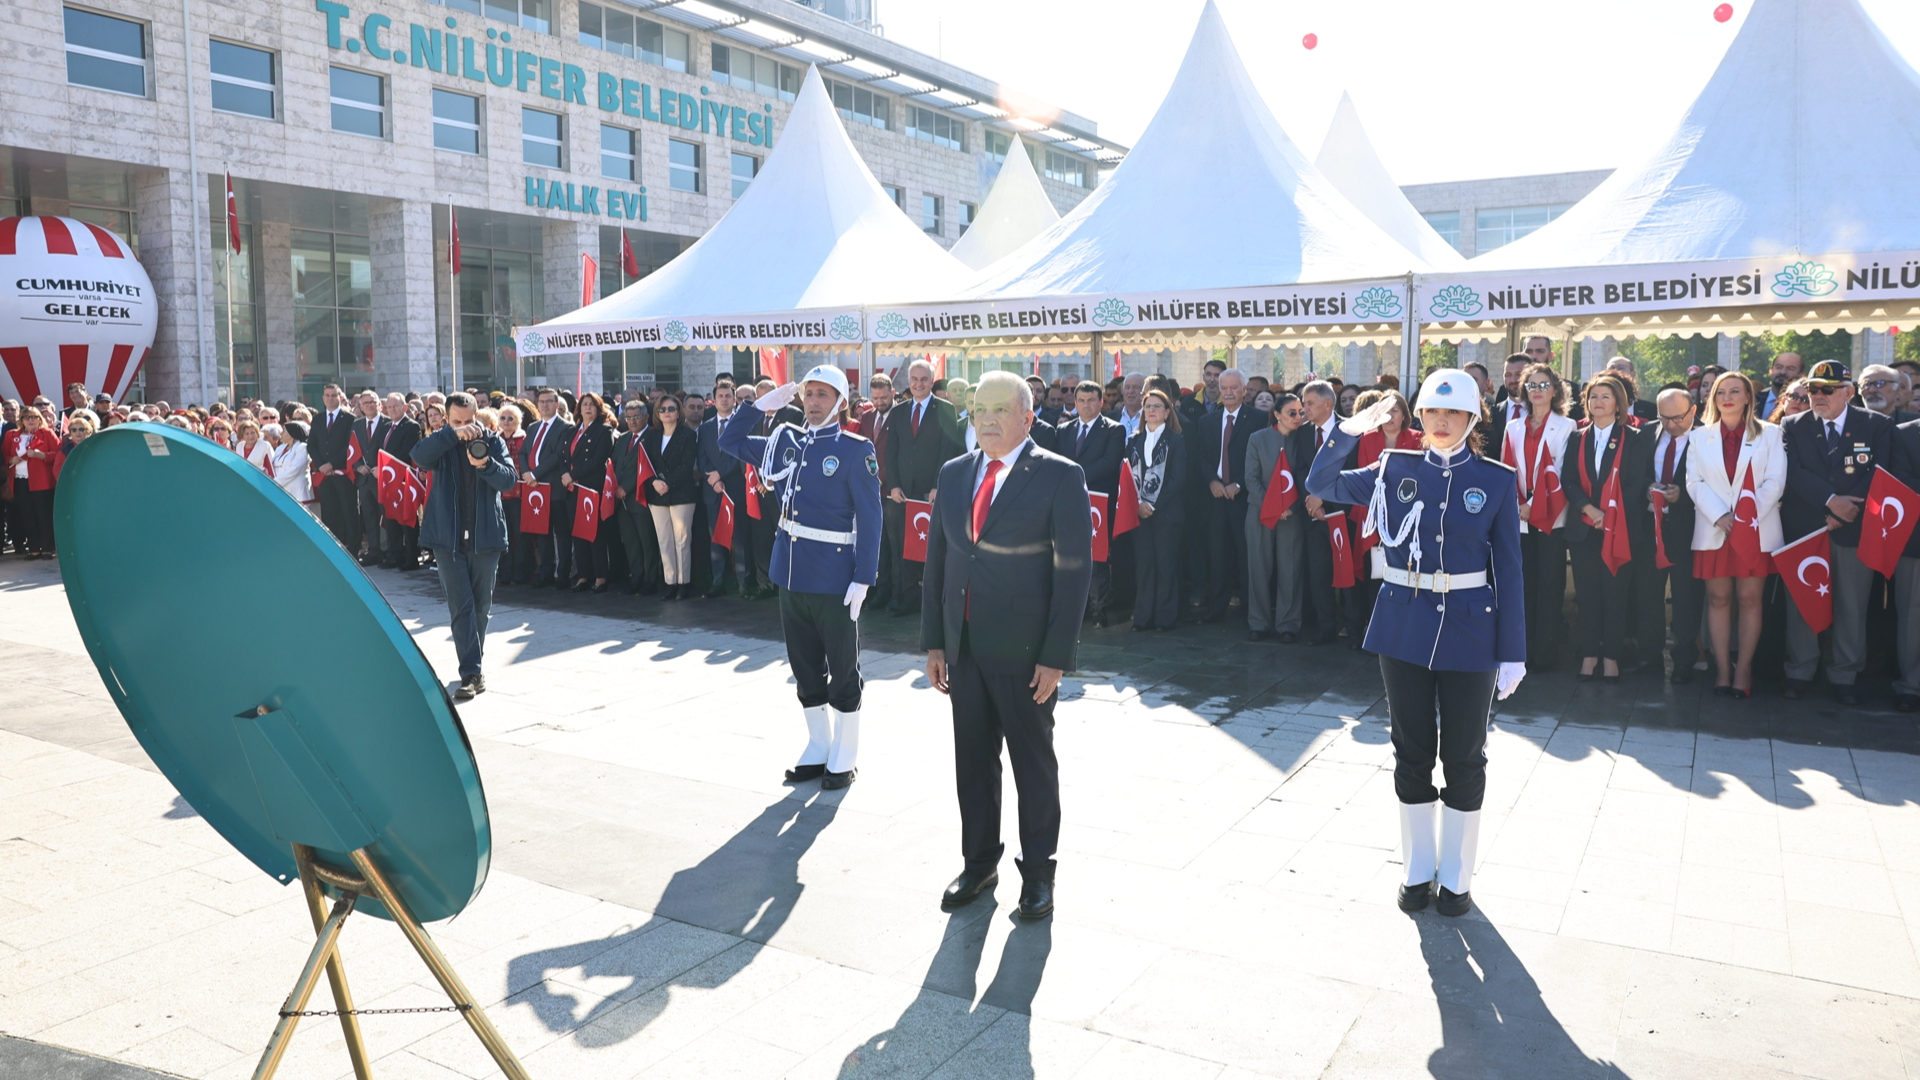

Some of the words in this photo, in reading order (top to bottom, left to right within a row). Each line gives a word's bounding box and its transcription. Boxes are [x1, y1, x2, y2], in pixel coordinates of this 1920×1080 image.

[598, 72, 773, 148] BELEDİYESİ
[525, 176, 600, 215] HALK
[607, 186, 647, 222] EVİ
[16, 278, 141, 297] CUMHURİYET
[1488, 284, 1595, 311] NİLÜFER
[1604, 268, 1761, 304] BELEDİYESİ
[45, 303, 130, 318] GELECEK
[913, 312, 983, 333] NİLÜFER
[987, 303, 1087, 329] BELEDİYESİ
[1138, 299, 1221, 321] NİLÜFER
[1228, 292, 1346, 318] BELEDİYESİ
[547, 331, 594, 349] NİLÜFER
[595, 324, 661, 345] BELEDİYESİ
[692, 322, 746, 340] NİLÜFER
[750, 318, 826, 338] BELEDİYESİ
